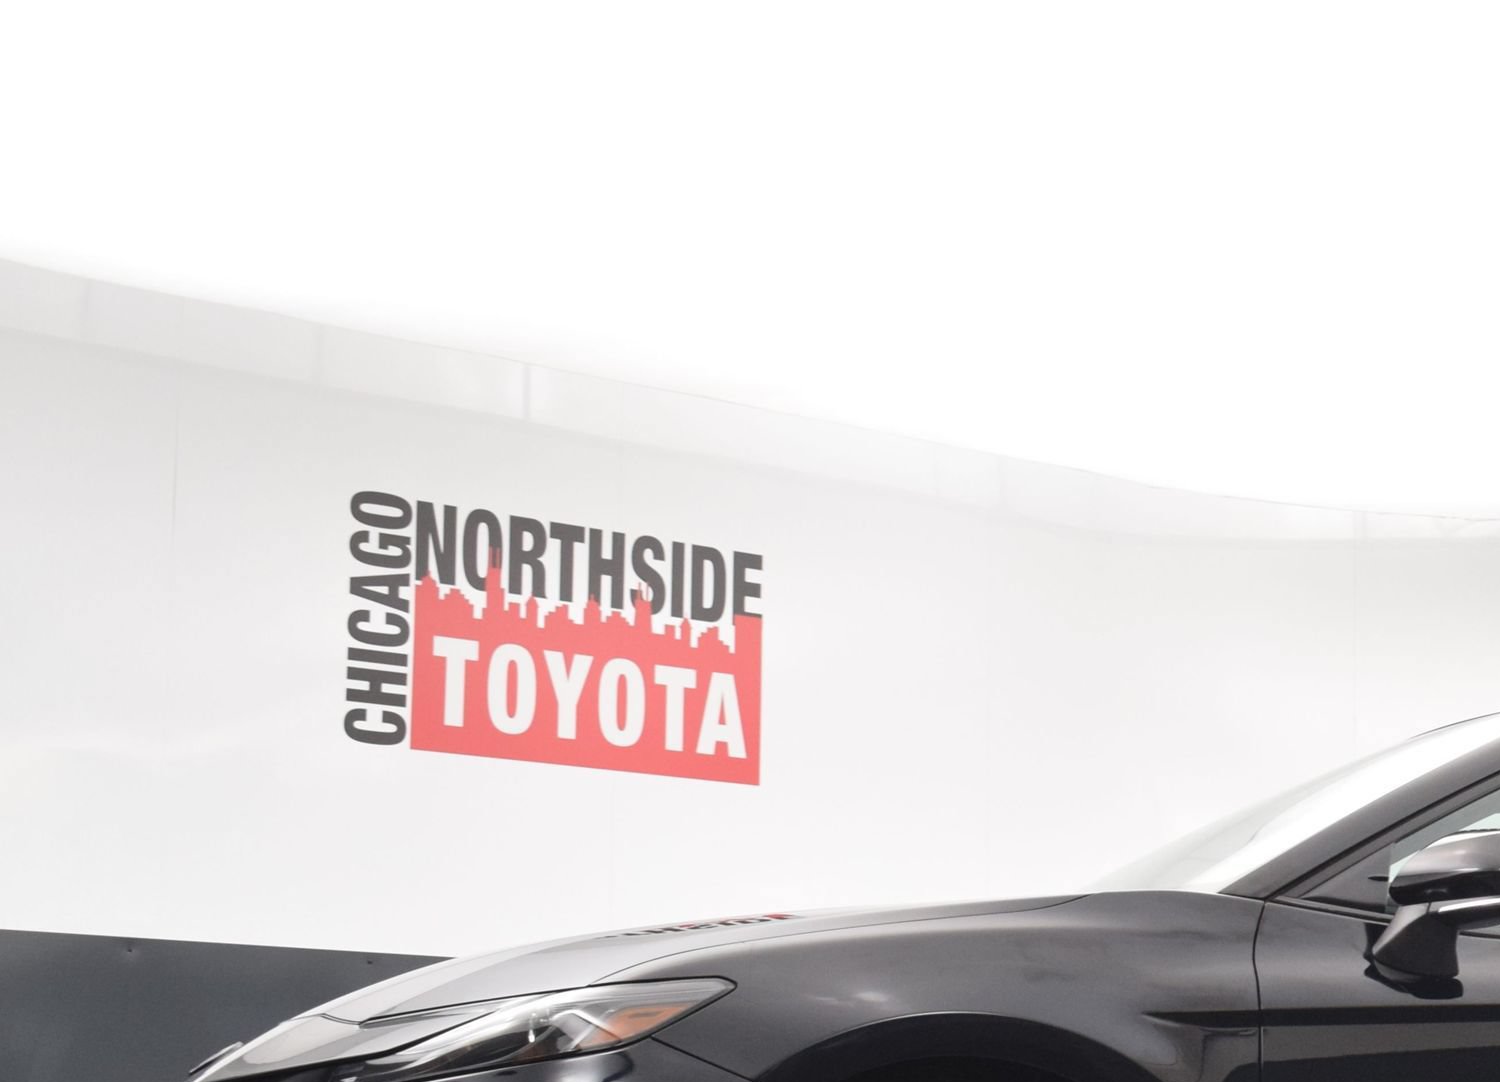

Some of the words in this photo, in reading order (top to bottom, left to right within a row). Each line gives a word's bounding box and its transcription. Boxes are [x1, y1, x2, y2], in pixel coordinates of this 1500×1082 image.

[344, 490, 412, 746] CHICAGO
[416, 500, 763, 623] NORTHSIDE
[433, 635, 748, 760] TOYOTA
